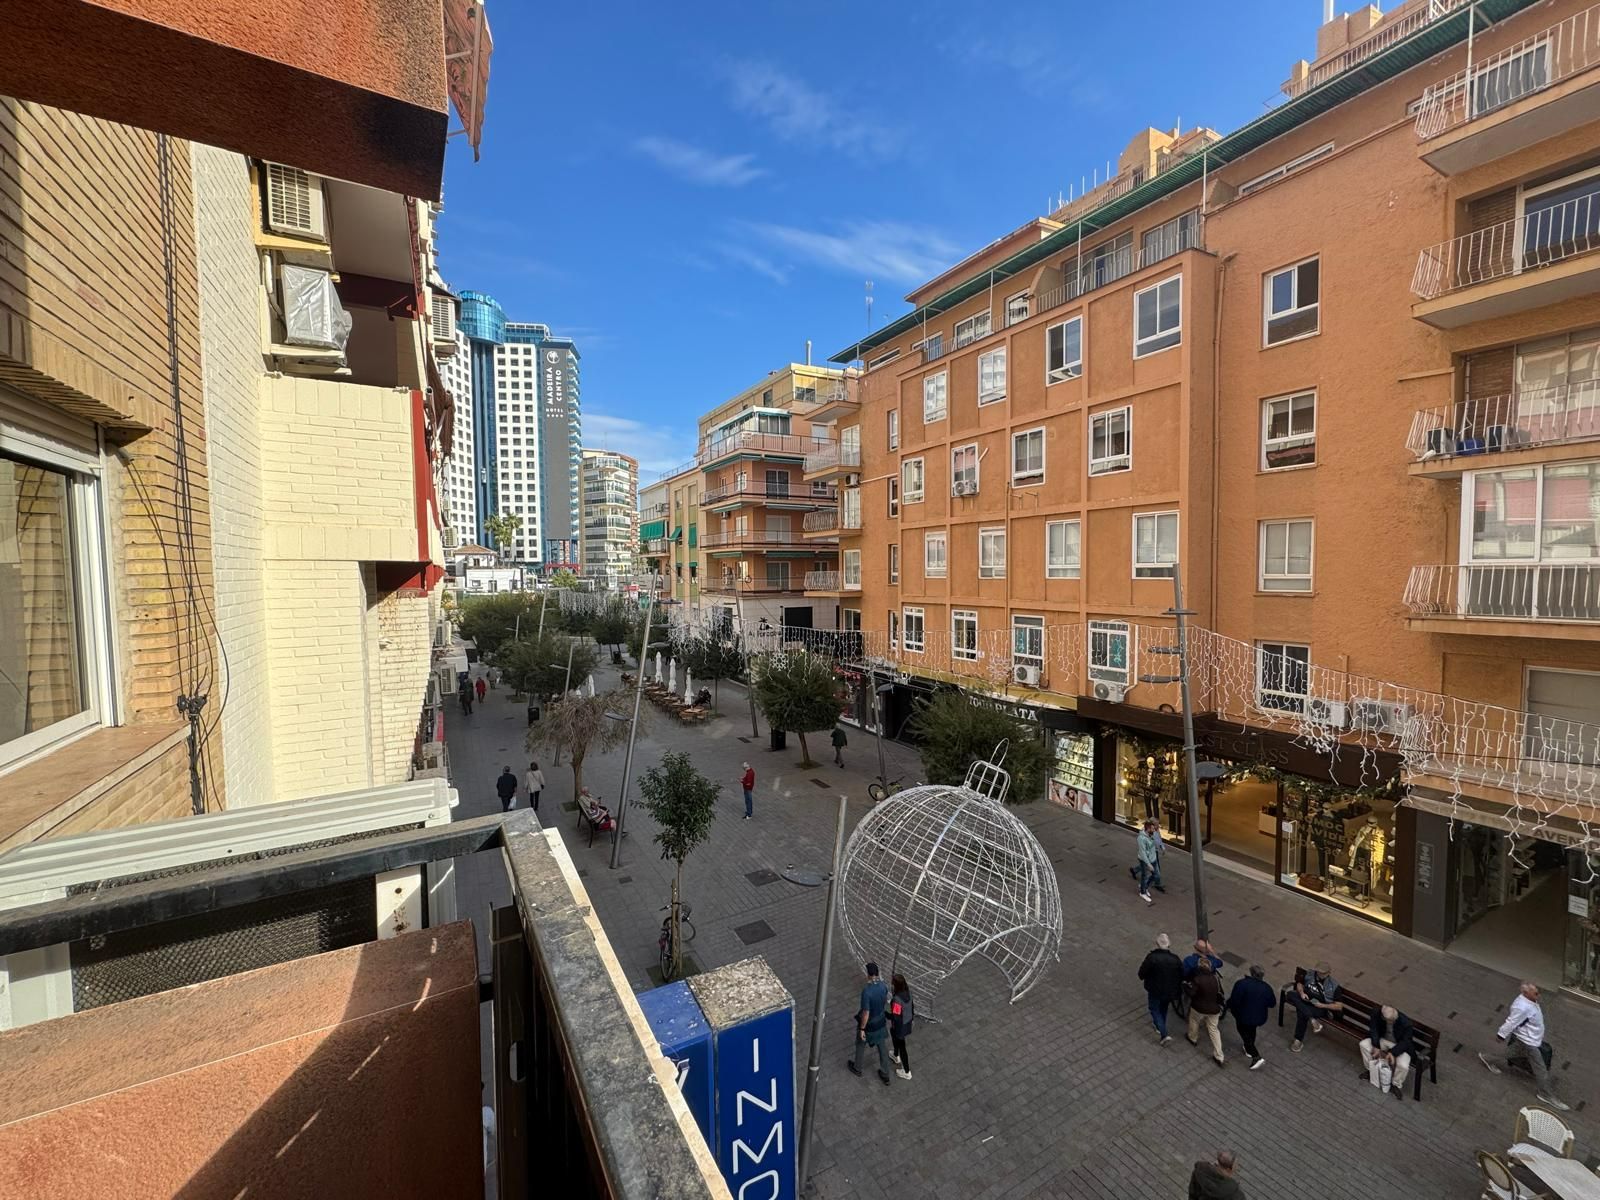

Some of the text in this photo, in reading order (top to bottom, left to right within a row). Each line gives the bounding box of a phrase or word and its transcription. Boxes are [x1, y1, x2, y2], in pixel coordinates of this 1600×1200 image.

[546, 367, 554, 405] MADEIRA
[555, 369, 563, 402] CENTRO
[1232, 736, 1289, 764] CLASS
